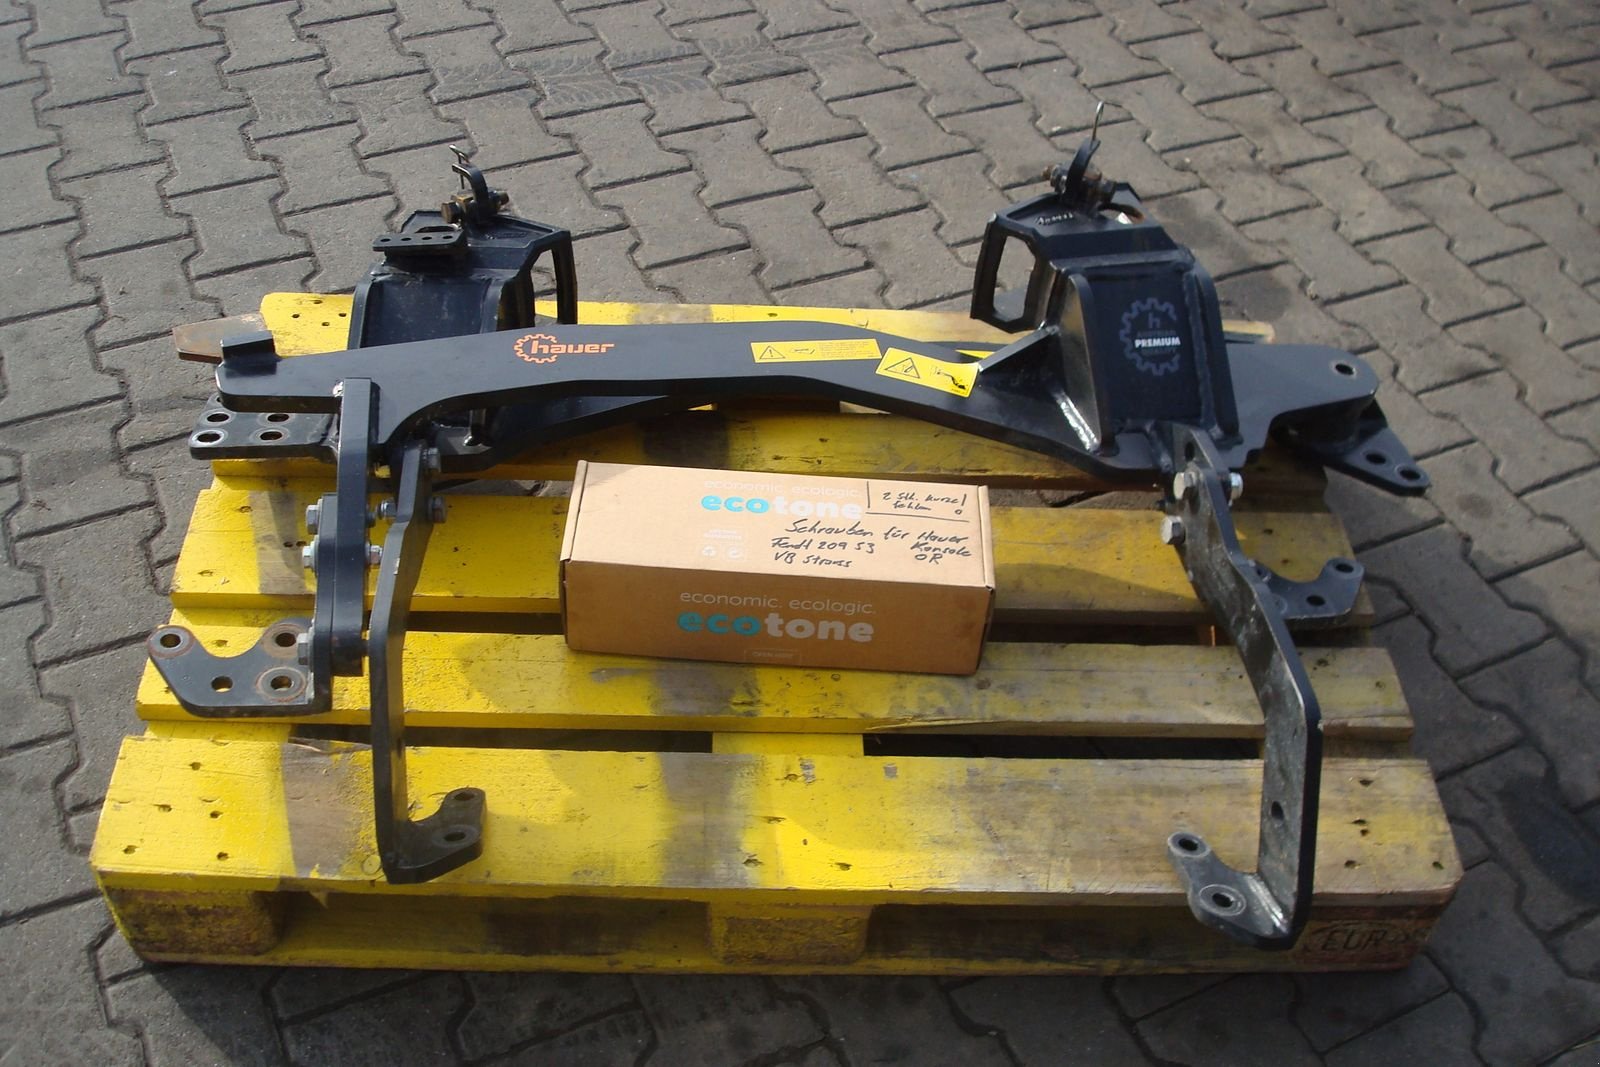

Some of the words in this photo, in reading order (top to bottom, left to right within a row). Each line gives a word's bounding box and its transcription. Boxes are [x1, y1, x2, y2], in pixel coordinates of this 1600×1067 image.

[530, 340, 615, 354] hauer
[1134, 336, 1181, 348] PREMIUM
[701, 494, 863, 520] ecotone
[785, 519, 873, 537] Schrauben
[917, 531, 968, 543] Hauer
[910, 541, 972, 557] Konsole
[677, 611, 875, 642] ecotone
